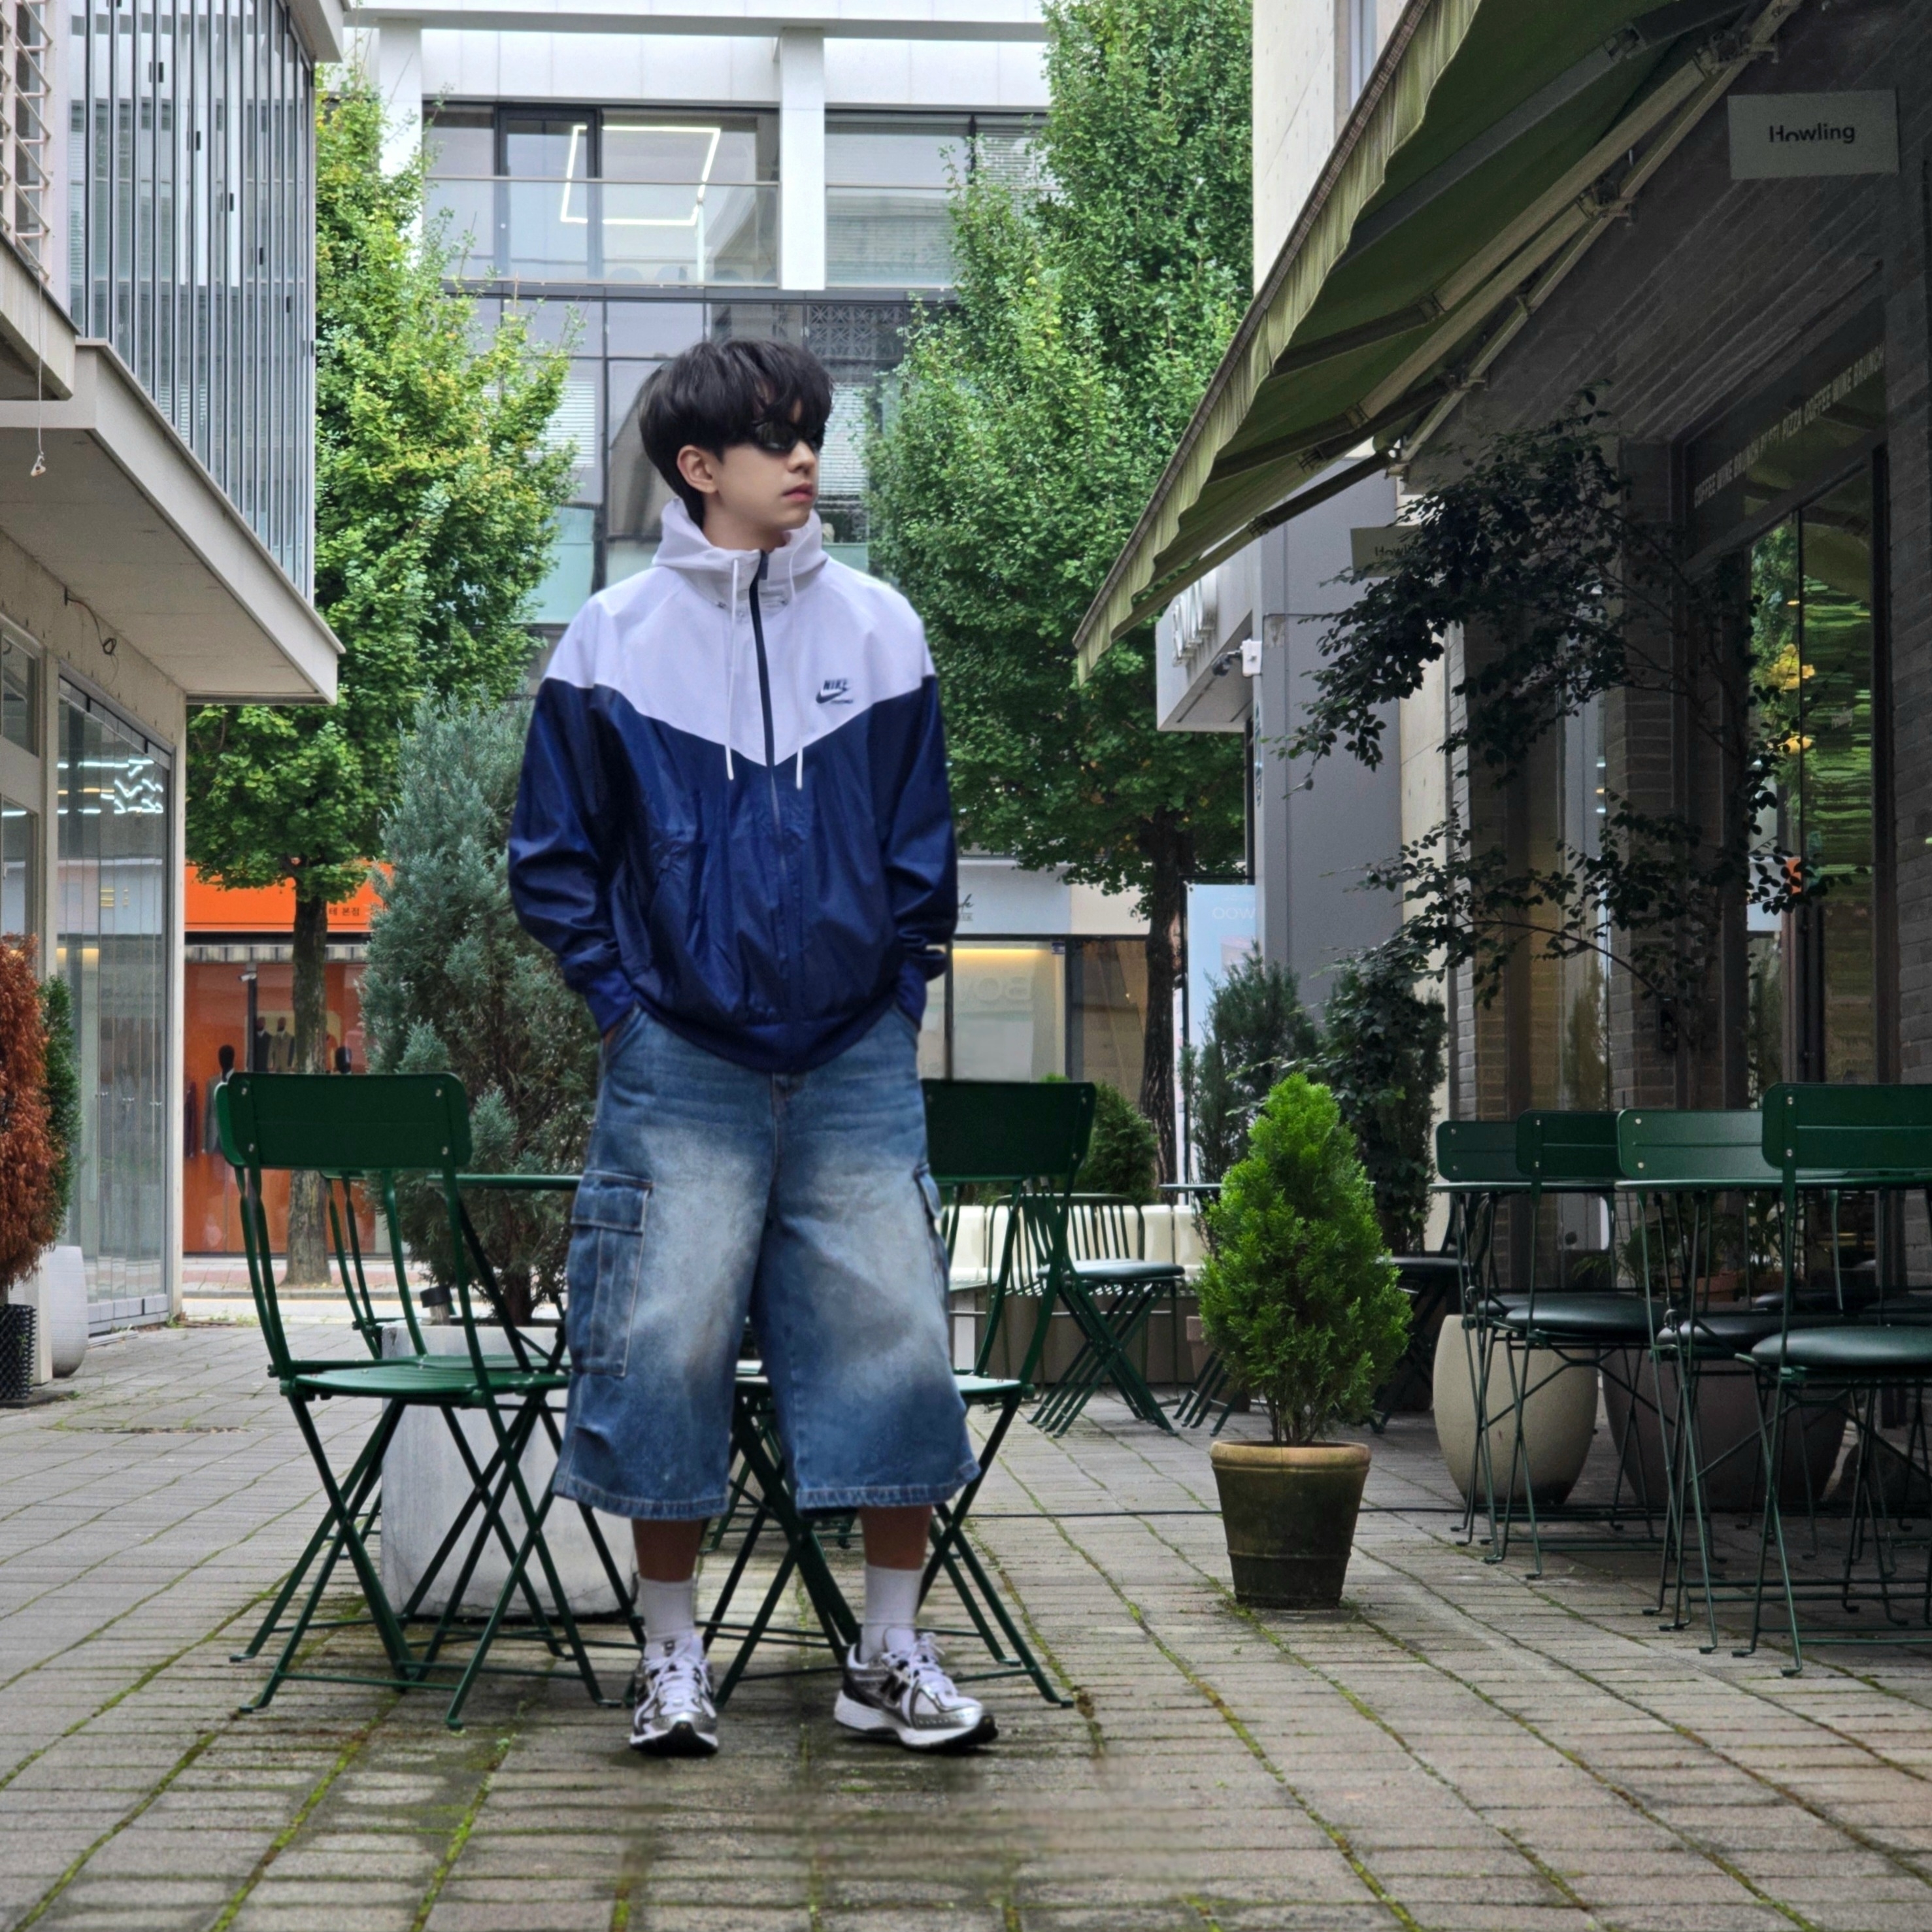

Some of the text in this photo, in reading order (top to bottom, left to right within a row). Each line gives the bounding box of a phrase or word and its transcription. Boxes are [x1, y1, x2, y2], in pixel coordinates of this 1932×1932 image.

[1769, 123, 1856, 144] Howling
[823, 678, 848, 691] NIKE
[342, 907, 359, 916] 본점
